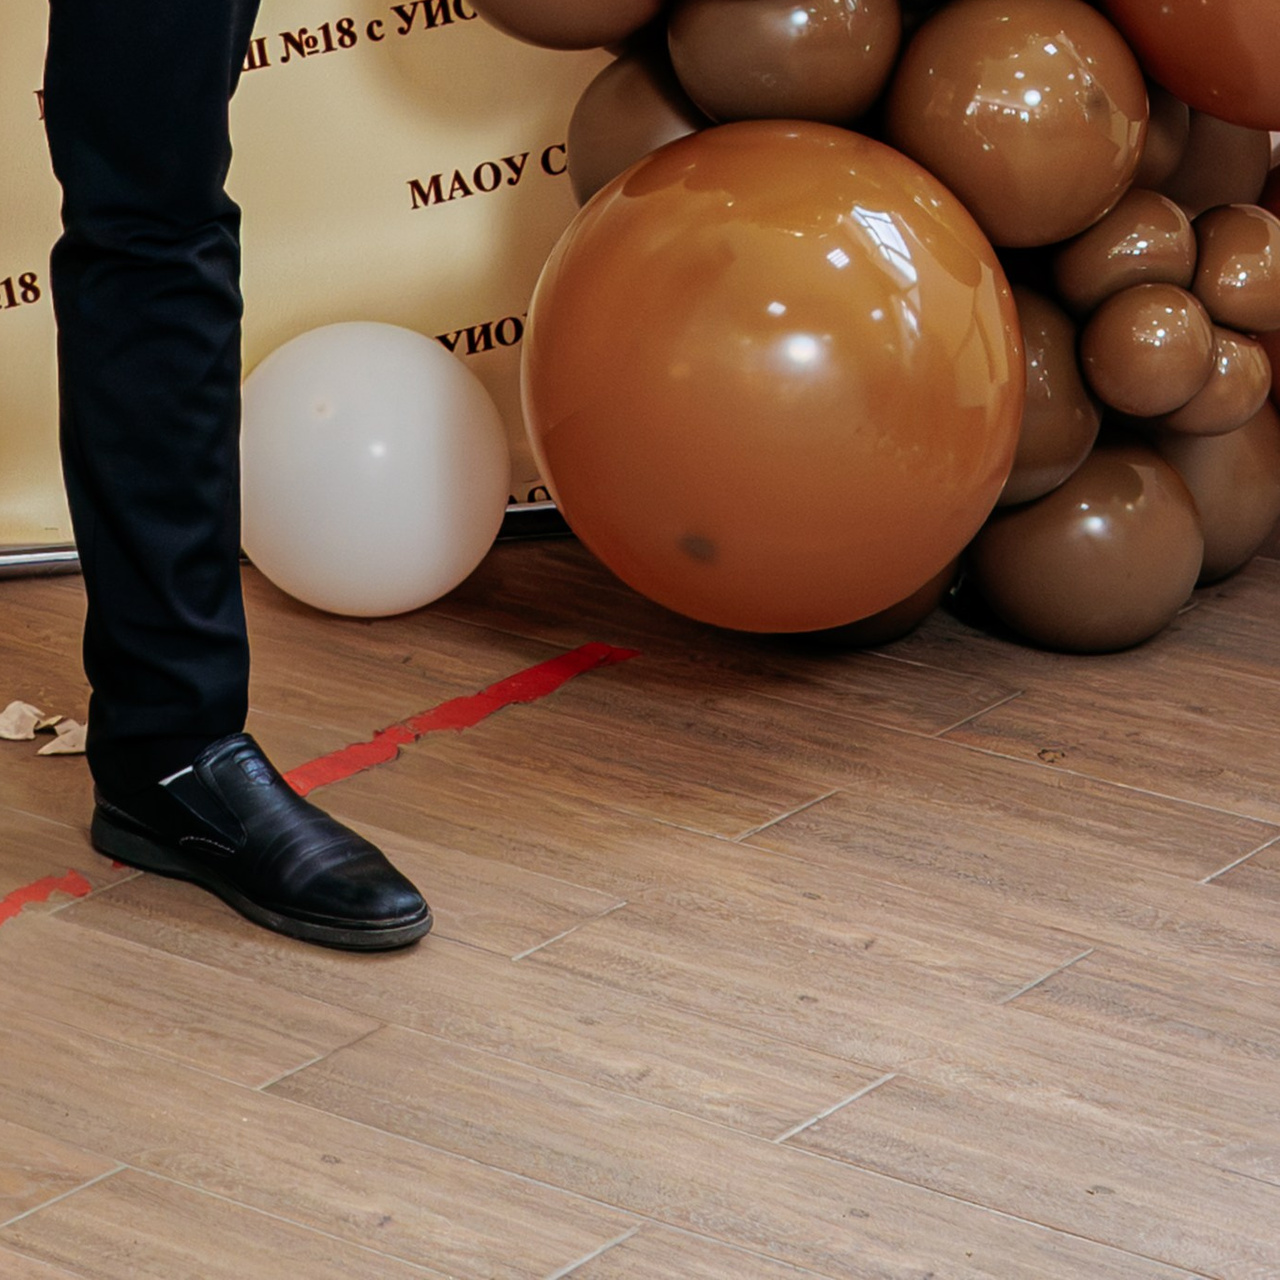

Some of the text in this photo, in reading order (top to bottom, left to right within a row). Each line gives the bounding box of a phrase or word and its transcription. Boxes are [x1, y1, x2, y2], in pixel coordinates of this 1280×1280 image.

[278, 17, 358, 64] №18
[365, 18, 386, 43] с
[407, 152, 530, 210] МАОУ
[435, 314, 525, 357] УИО
